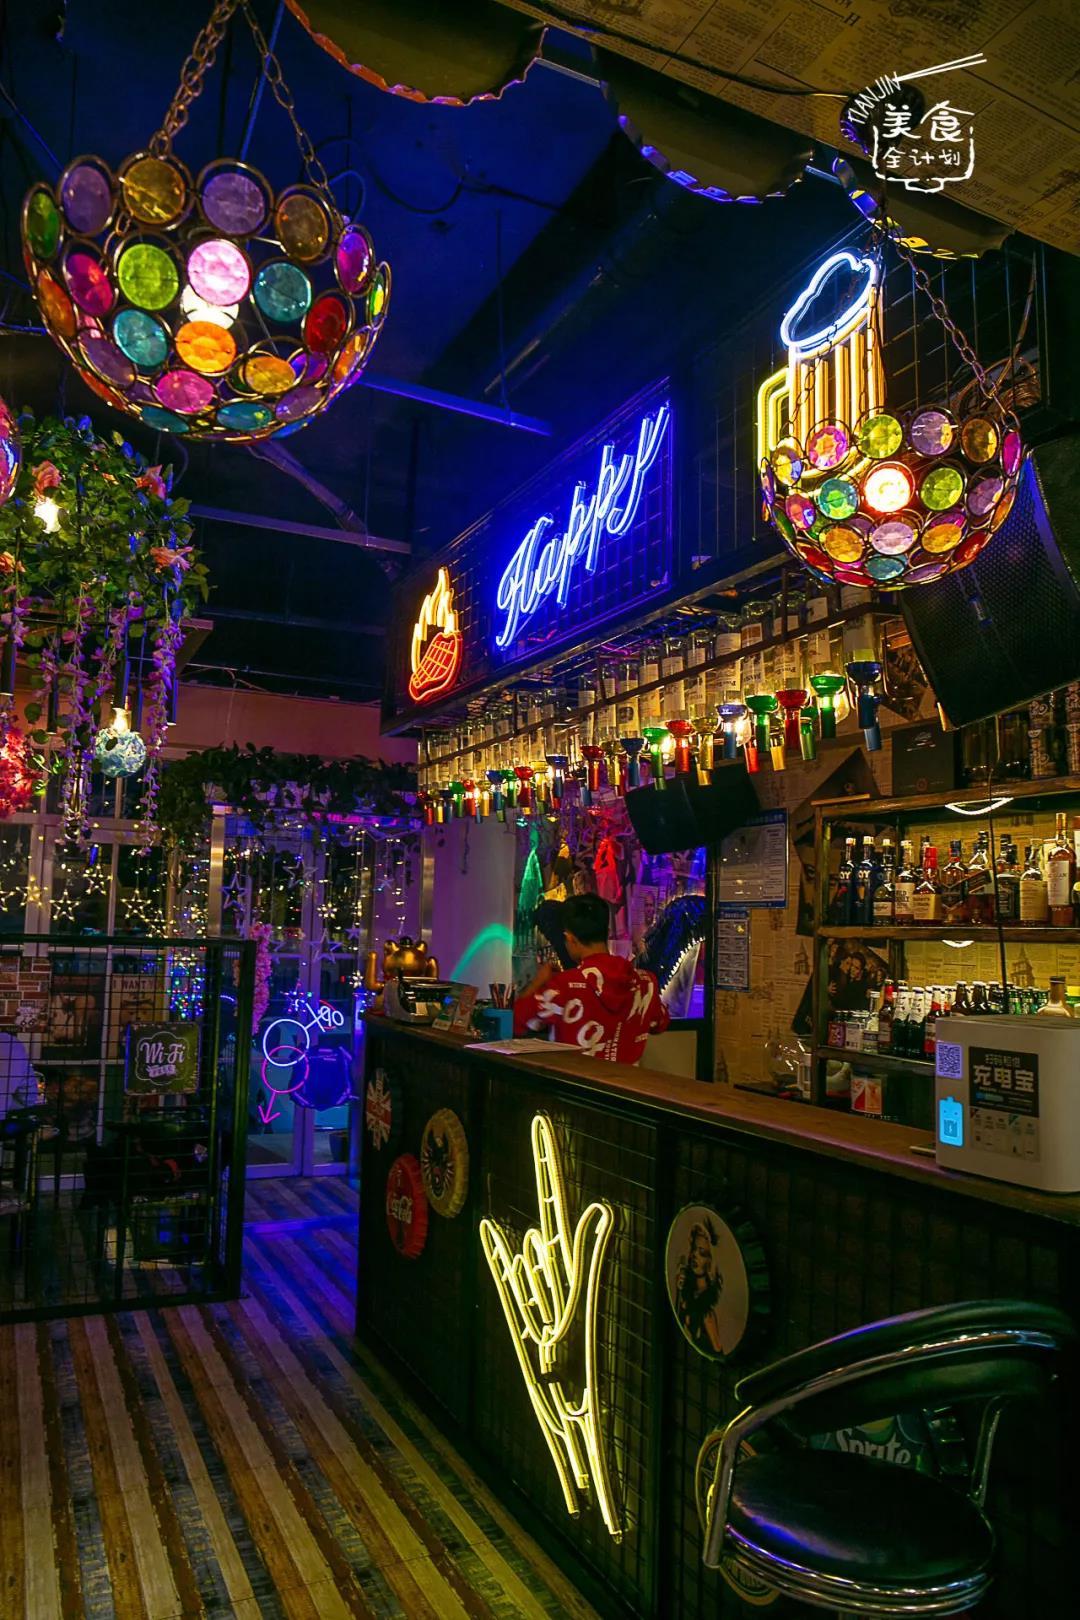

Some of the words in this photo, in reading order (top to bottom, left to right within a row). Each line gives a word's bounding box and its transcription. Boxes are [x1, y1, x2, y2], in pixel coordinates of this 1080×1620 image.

[495, 402, 671, 648] Happy
[139, 1041, 187, 1065] Wi-Fi
[972, 1064, 1035, 1093] 充电宝
[835, 1427, 912, 1465] Sprite
